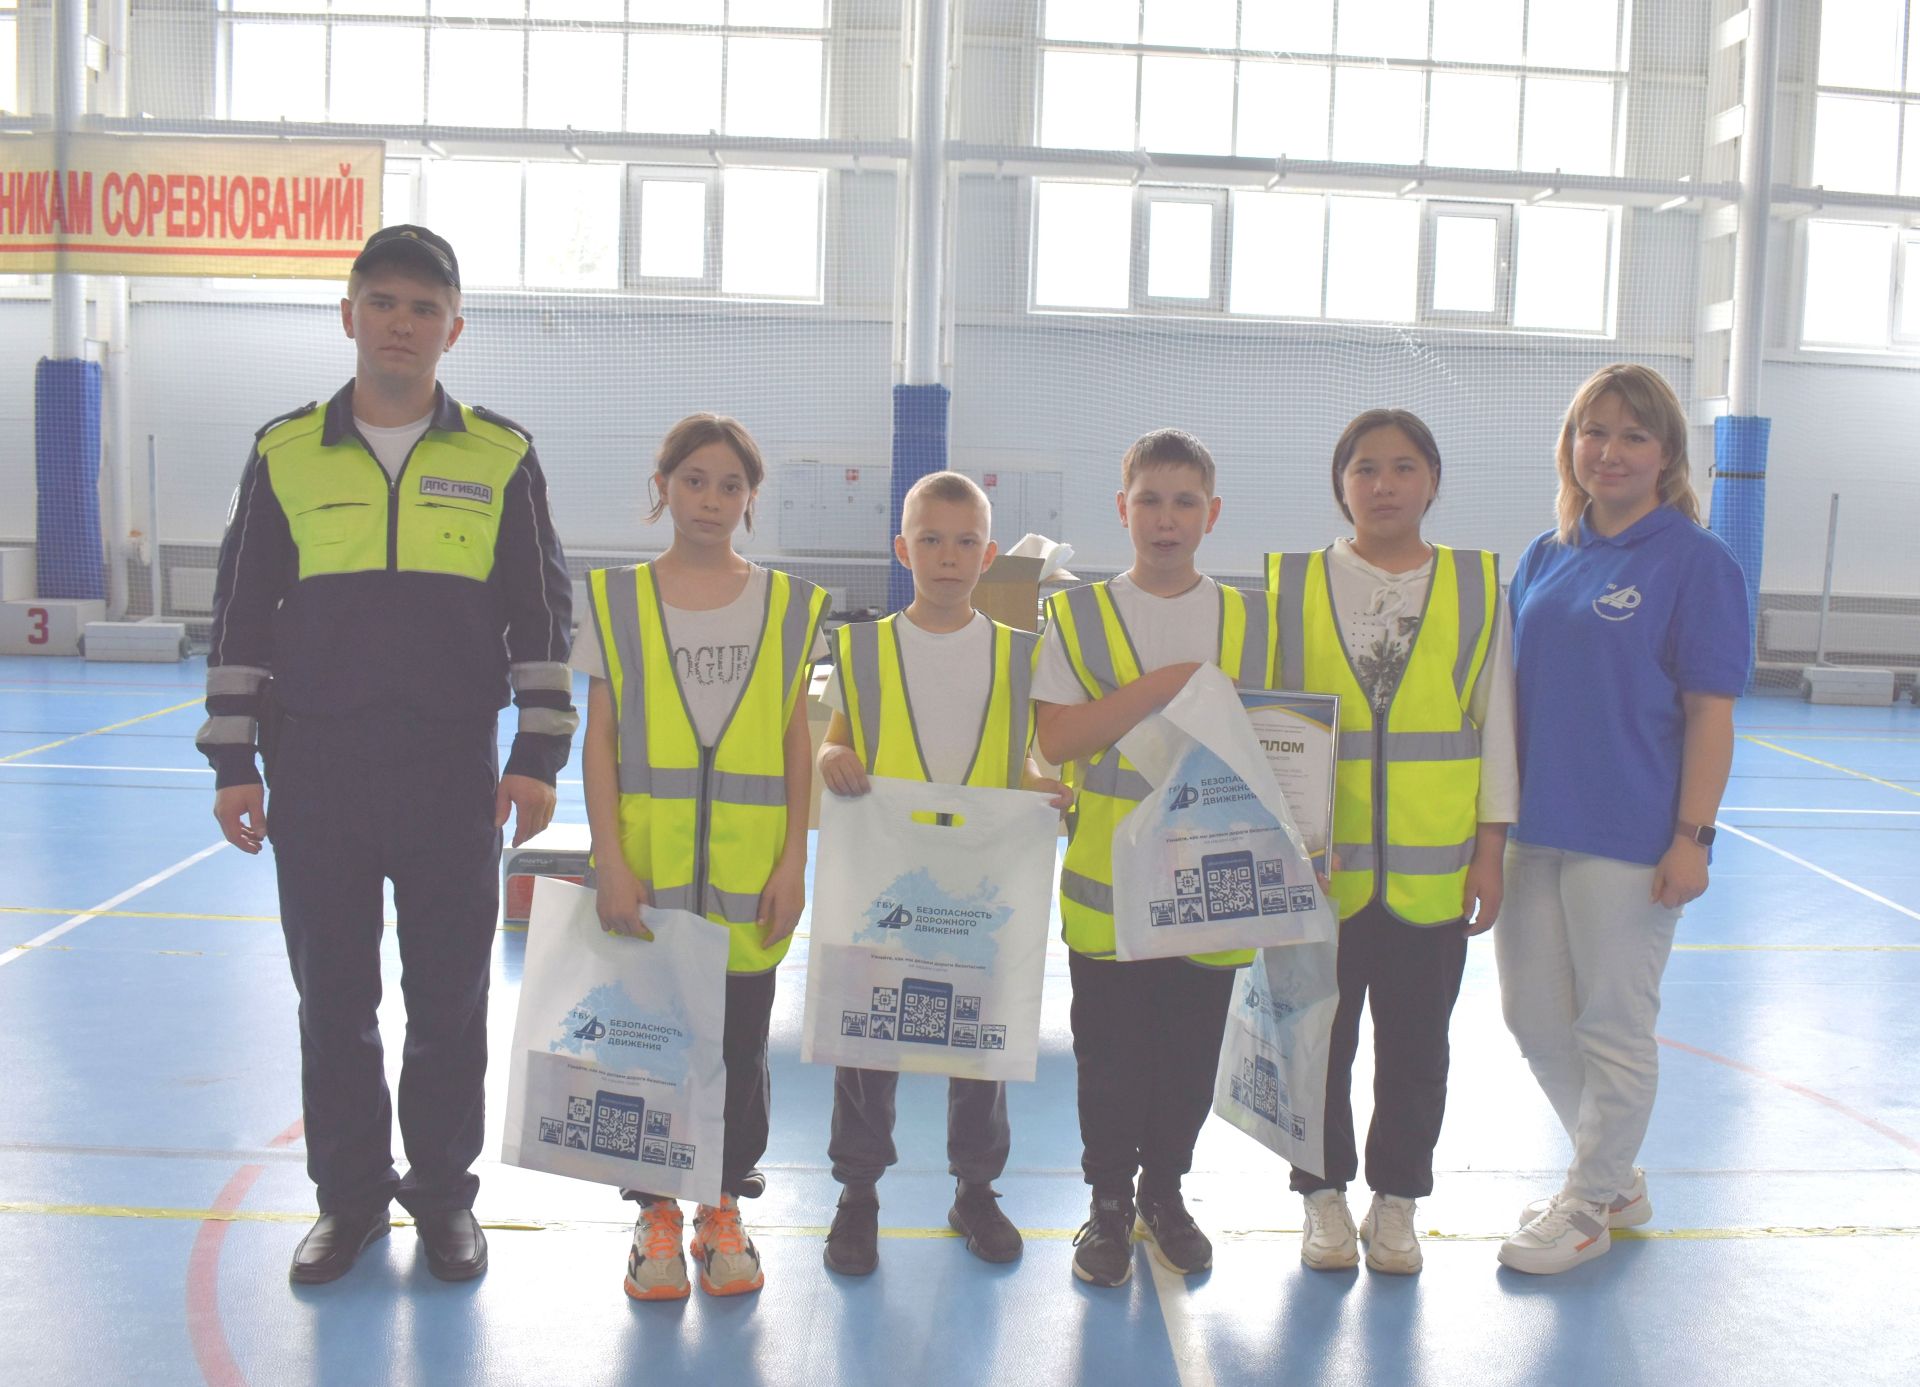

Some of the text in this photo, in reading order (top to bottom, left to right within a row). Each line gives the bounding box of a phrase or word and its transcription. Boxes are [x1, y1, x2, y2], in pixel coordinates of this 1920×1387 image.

[102, 162, 364, 241] СОРЕВНОВАНИЙ!
[424, 480, 489, 500] ДПС ГИБДД
[27, 607, 49, 645] 3
[876, 901, 896, 909] ГБУ
[916, 906, 993, 920] БЕЗОПАСНОСТЬ
[915, 915, 977, 927] ДОРОЖНОГО
[914, 924, 969, 936] ДВИЖЕНИЯ
[573, 1011, 592, 1020] ГБУ
[609, 1019, 683, 1038] БЕЗОПАСНОСТЬ
[609, 1028, 669, 1043] ДОРОЖНОГО
[607, 1037, 662, 1052] ДВИЖЕНИЯ
